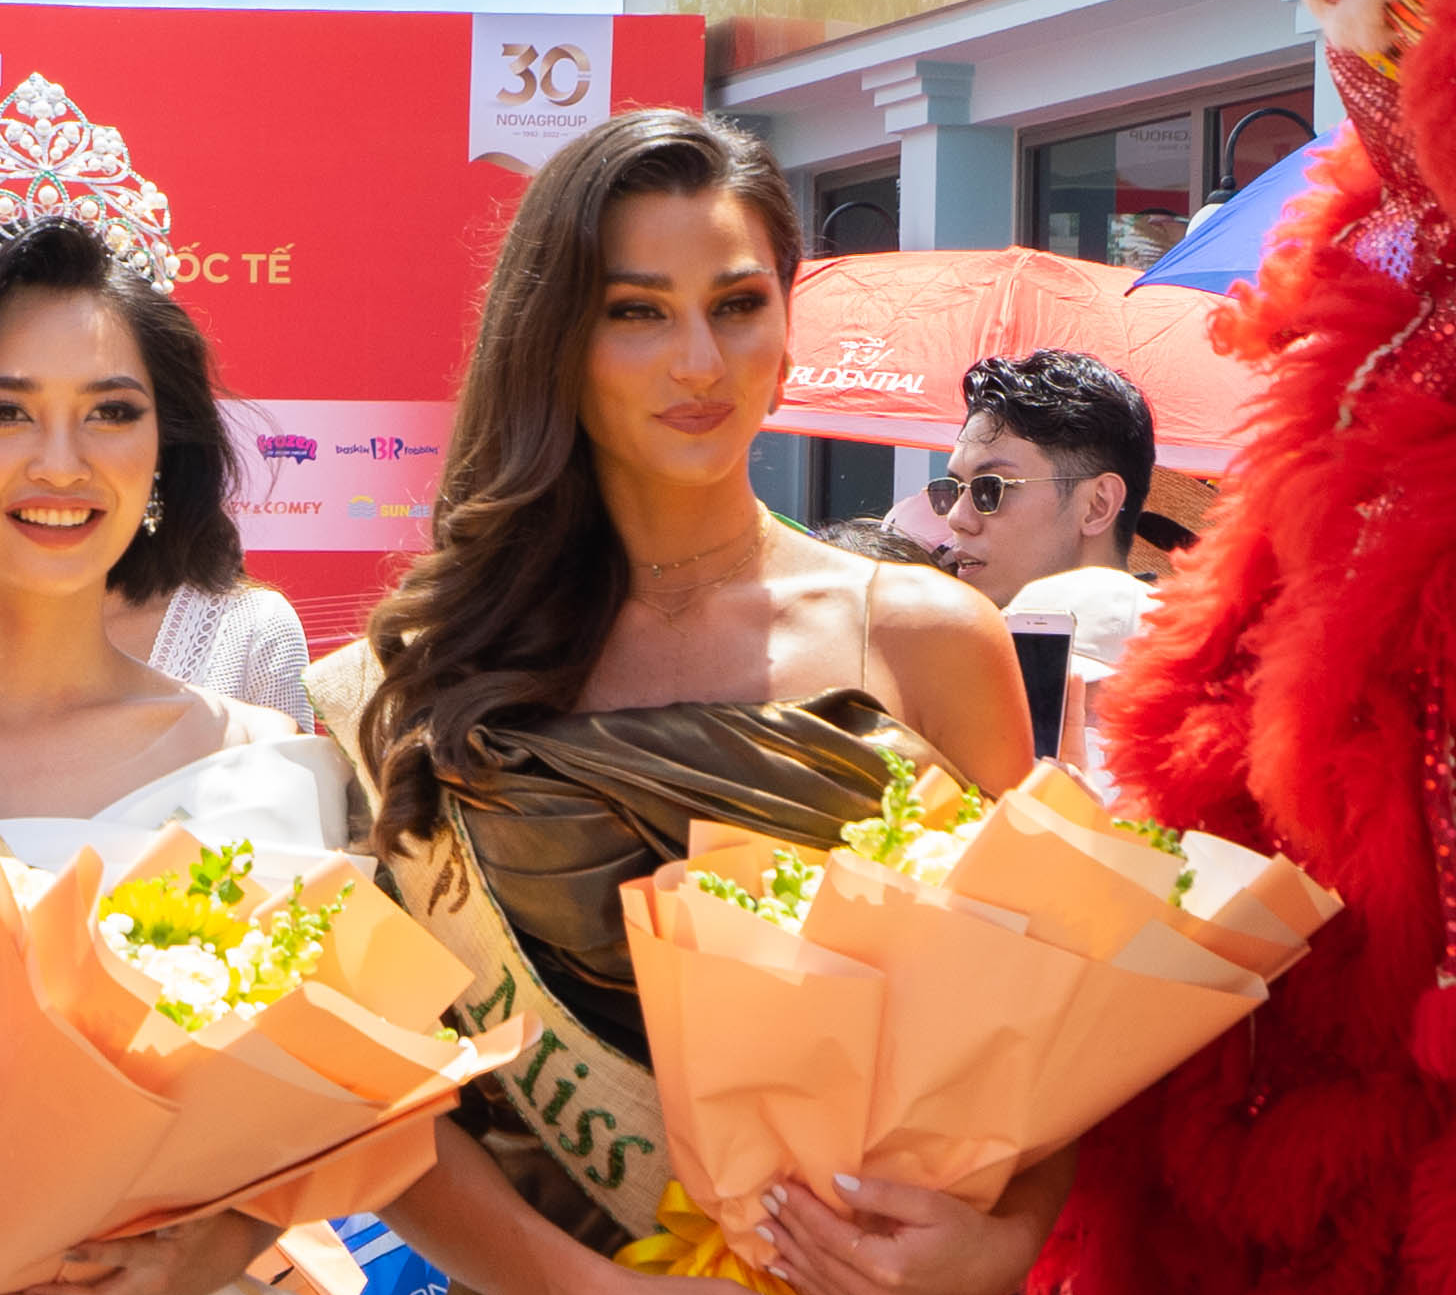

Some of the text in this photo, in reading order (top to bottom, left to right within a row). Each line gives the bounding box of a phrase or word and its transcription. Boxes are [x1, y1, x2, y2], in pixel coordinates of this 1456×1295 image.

[496, 43, 591, 107] 30
[496, 114, 587, 127] NOVAGROUP
[241, 243, 295, 284] TẾ
[787, 365, 925, 394] RUDENTIAL
